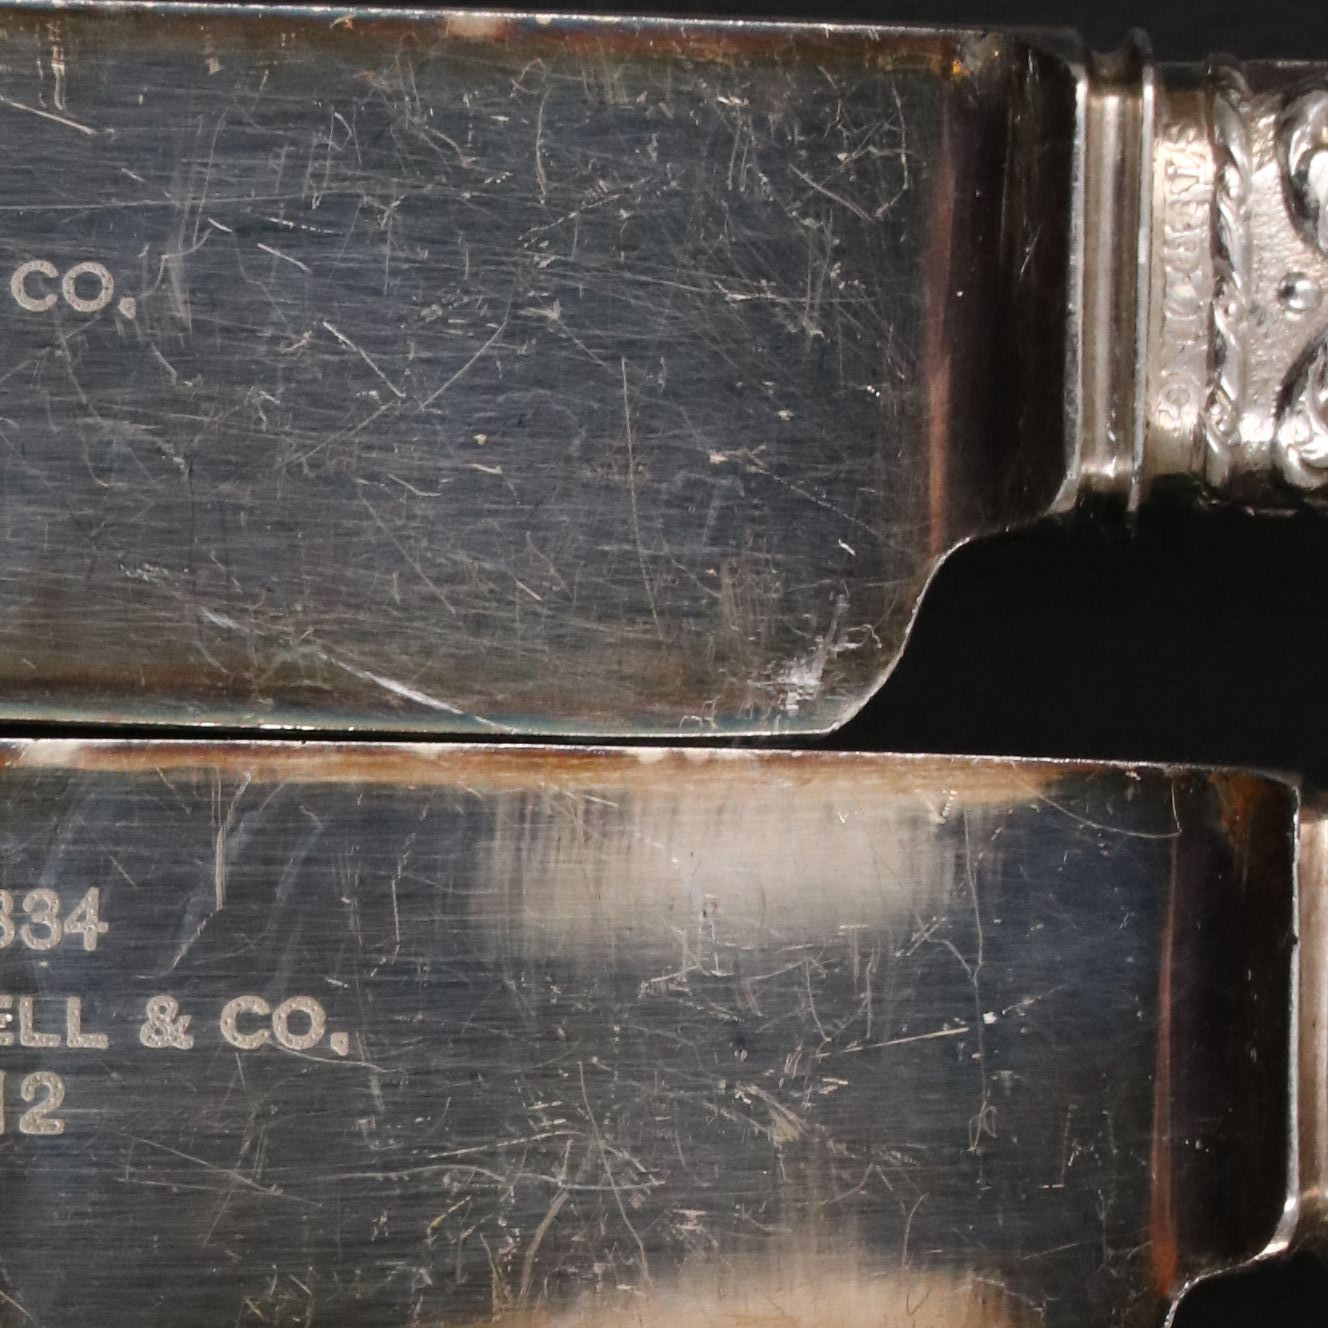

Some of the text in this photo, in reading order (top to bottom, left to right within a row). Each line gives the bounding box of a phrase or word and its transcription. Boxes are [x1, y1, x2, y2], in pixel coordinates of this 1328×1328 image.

[11, 260, 137, 319] CO.
[140, 995, 194, 1050] &
[221, 996, 350, 1056] CO.
